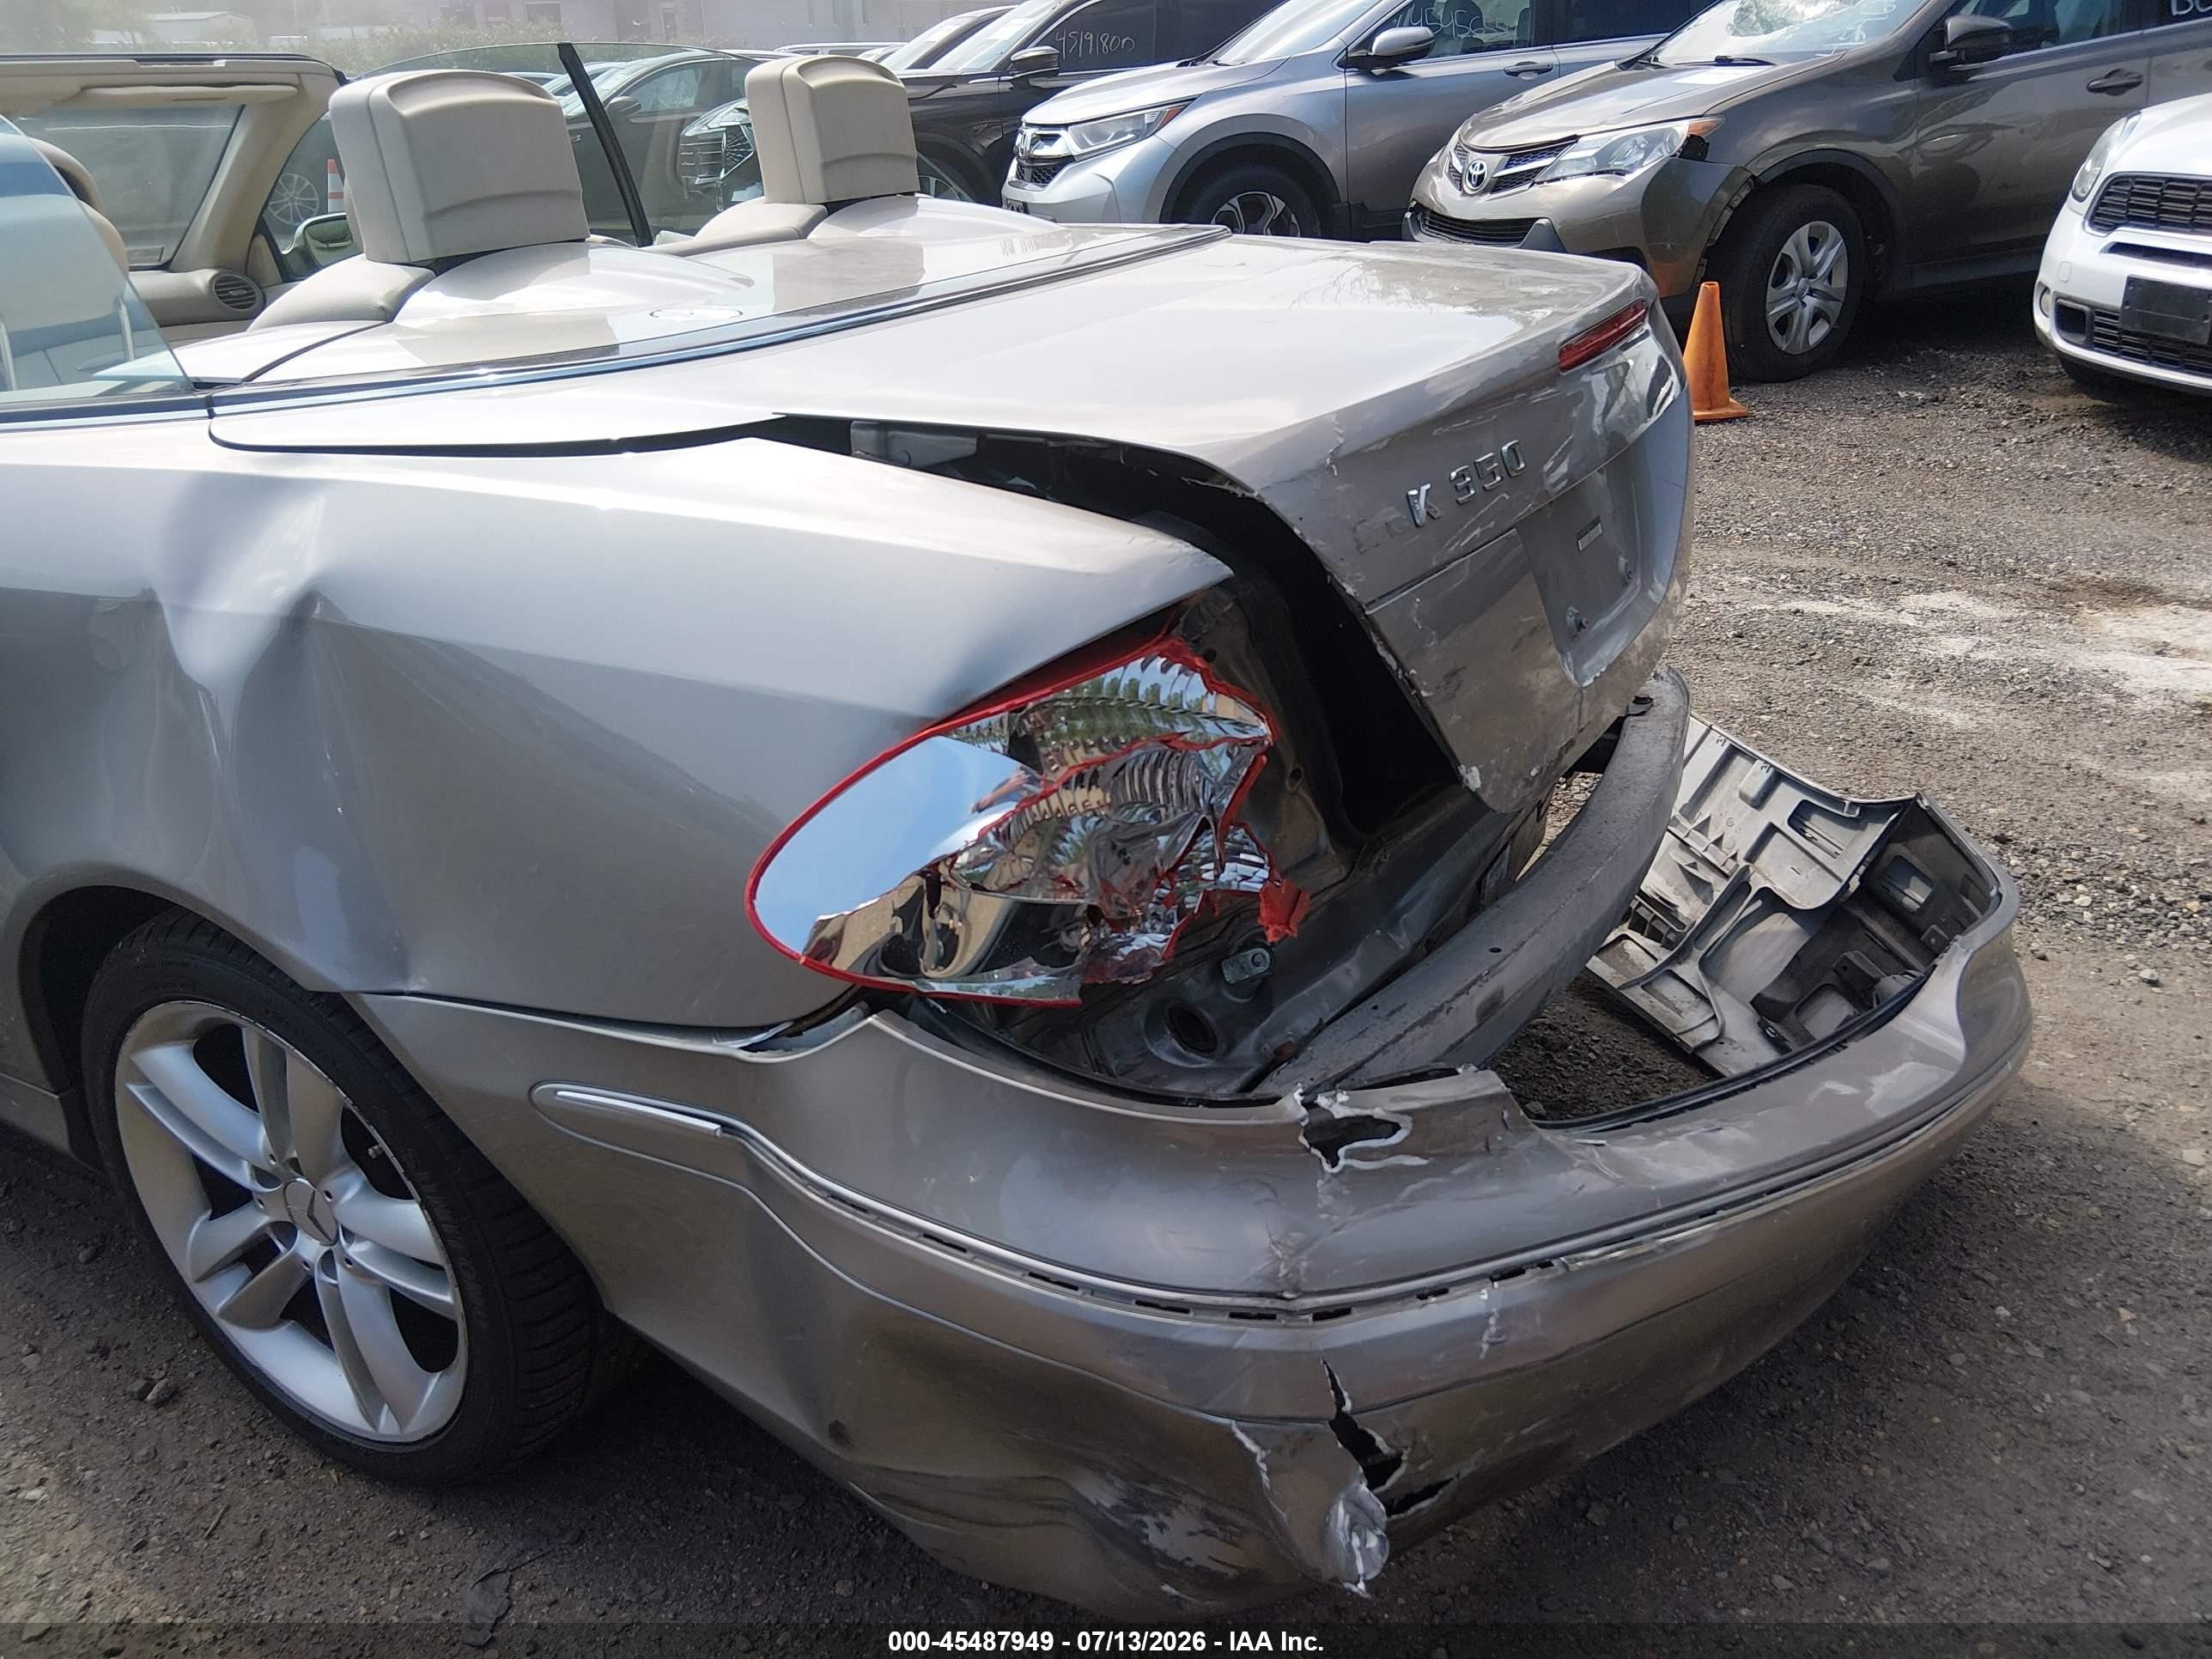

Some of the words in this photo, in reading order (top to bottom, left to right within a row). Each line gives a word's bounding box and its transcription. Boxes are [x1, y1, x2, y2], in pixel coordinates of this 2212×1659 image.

[1054, 27, 1136, 61] 45191800
[1406, 482, 1442, 528] K
[1449, 439, 1528, 506] 350
